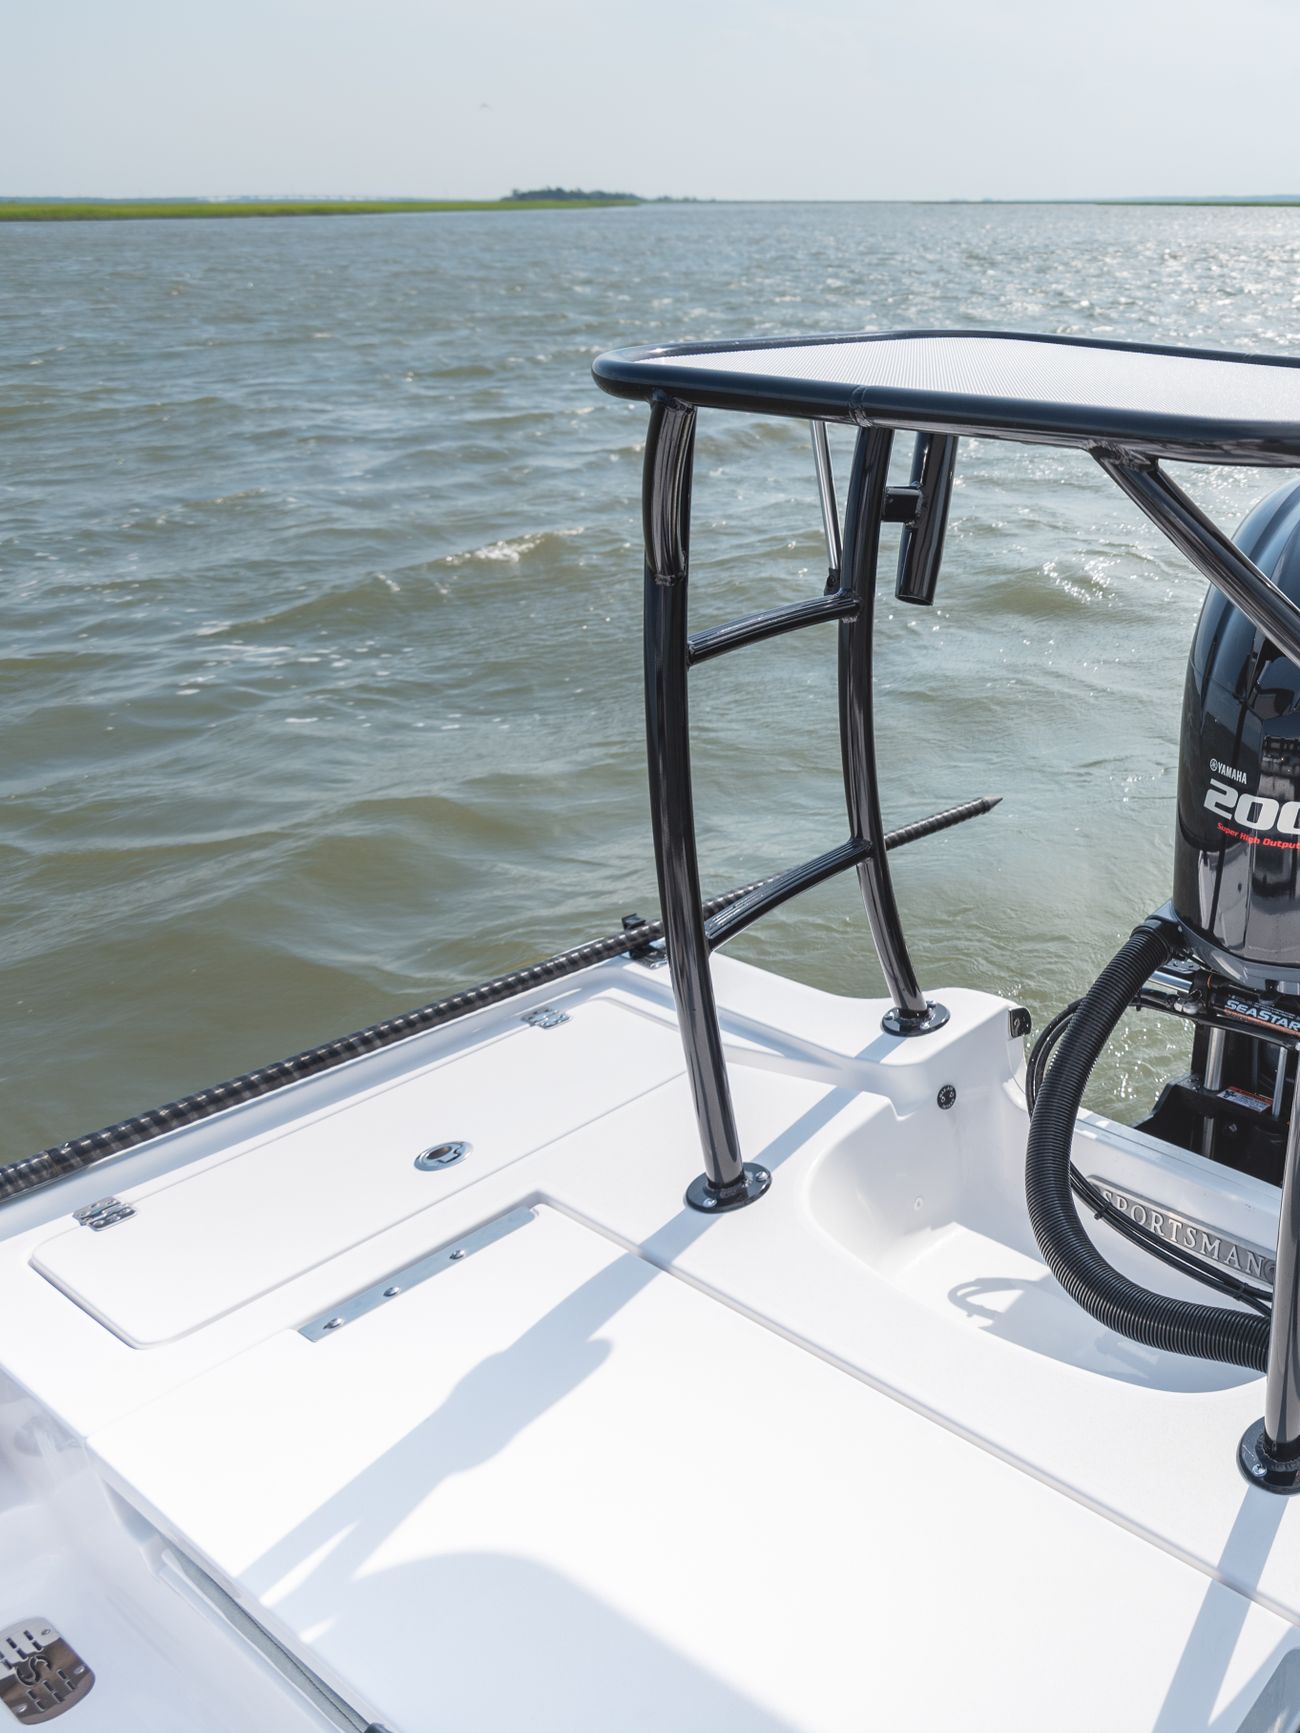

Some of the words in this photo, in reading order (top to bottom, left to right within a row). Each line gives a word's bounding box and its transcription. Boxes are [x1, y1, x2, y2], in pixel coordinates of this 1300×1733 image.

[1217, 761, 1247, 785] YAMAHA
[1217, 822, 1239, 838] Super
[1240, 832, 1260, 845] High
[1263, 838, 1300, 850] Output
[1101, 1189, 1264, 1278] SPORTSMAN
